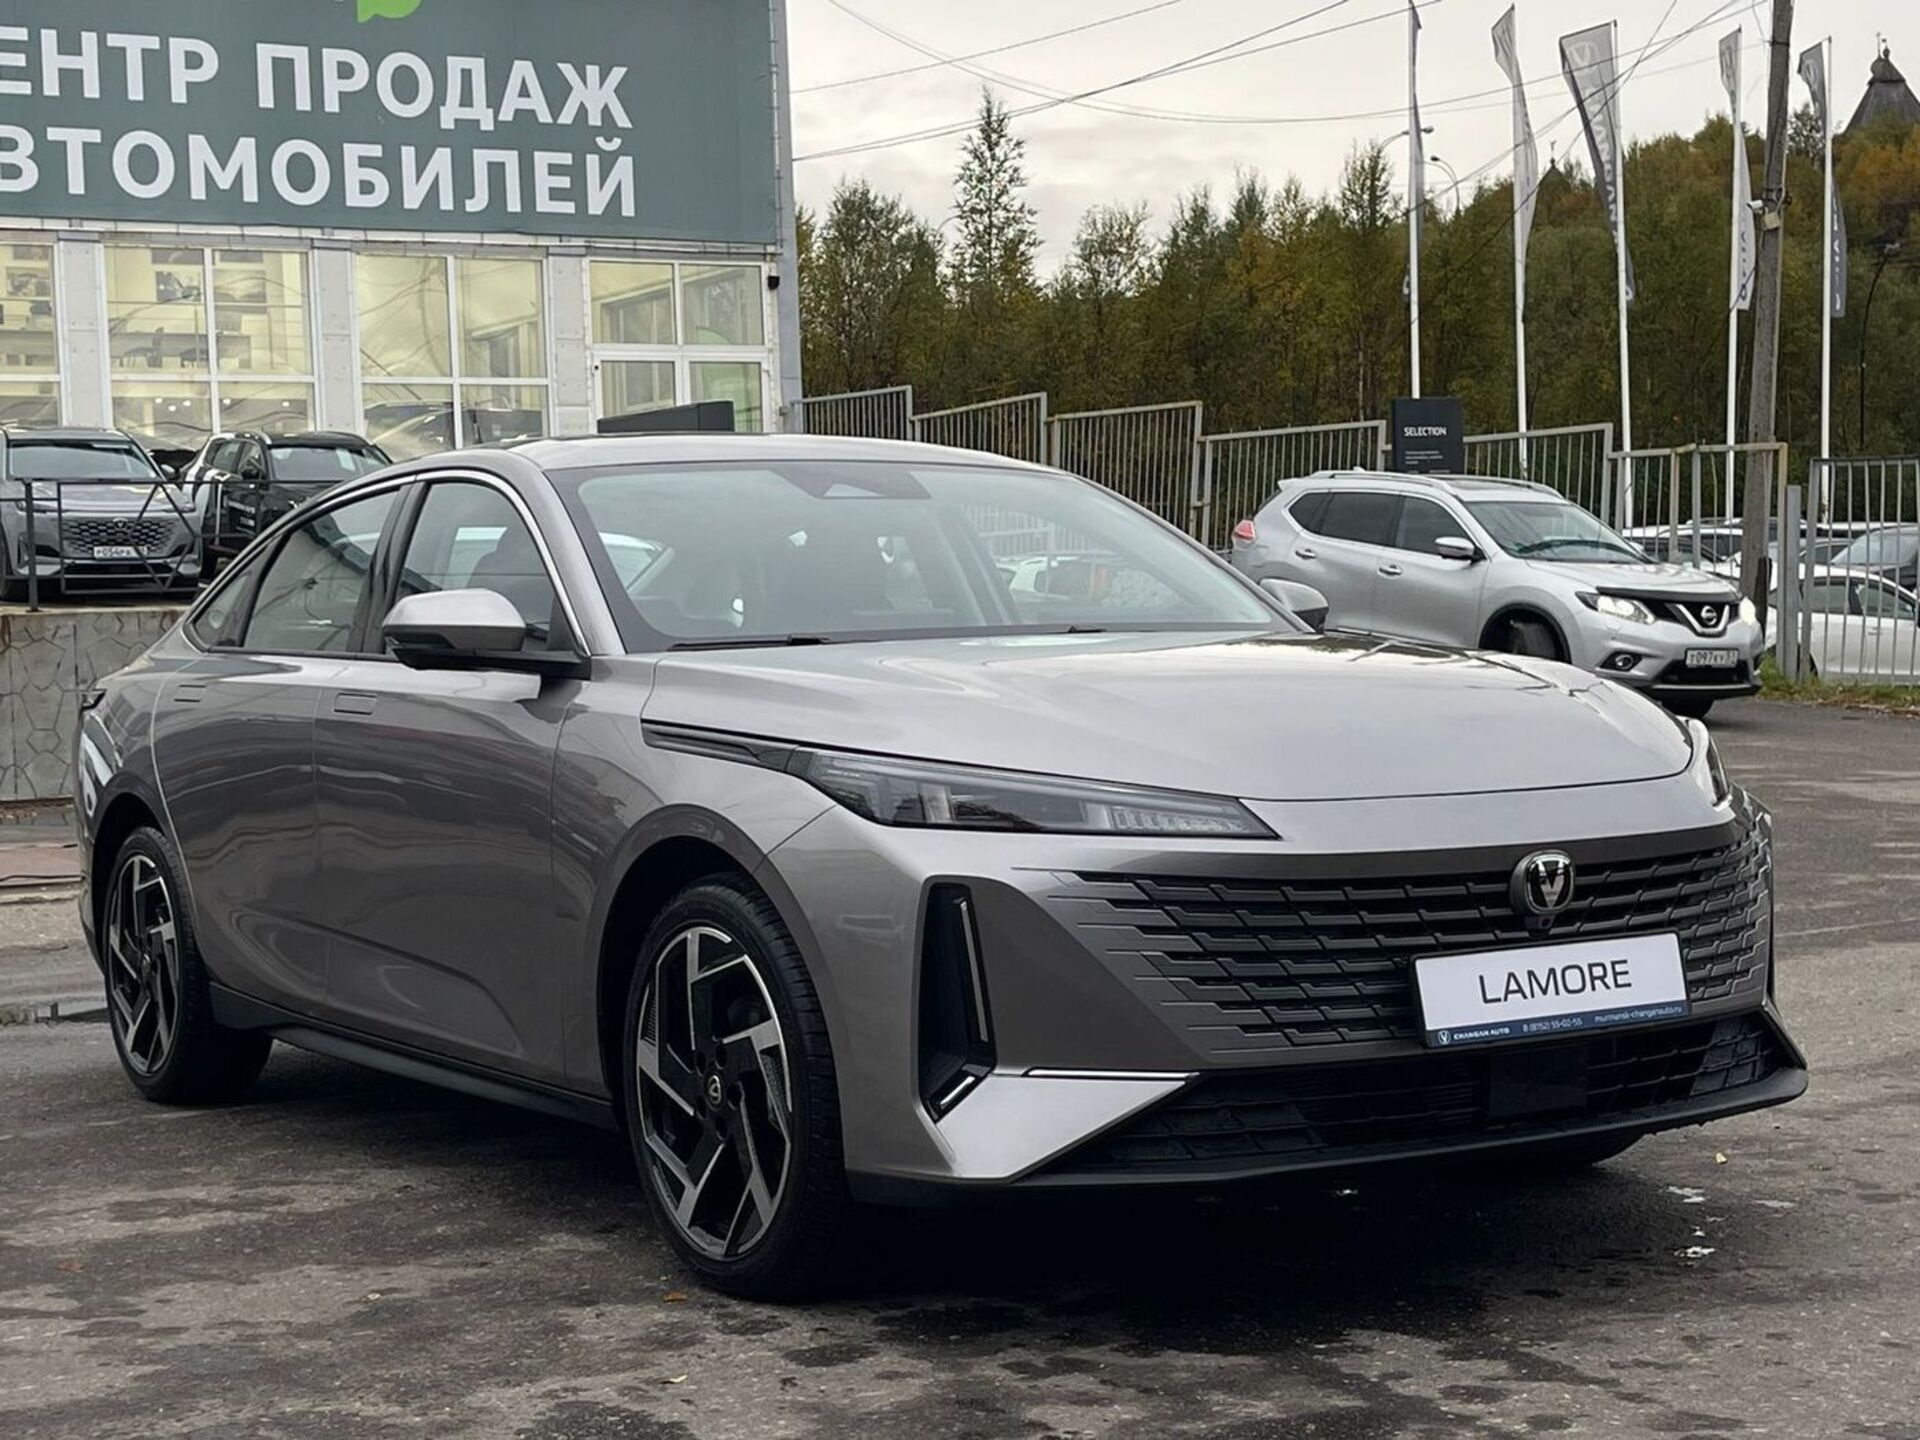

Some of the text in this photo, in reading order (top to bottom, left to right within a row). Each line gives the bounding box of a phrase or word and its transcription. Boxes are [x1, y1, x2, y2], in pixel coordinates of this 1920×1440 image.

[256, 42, 633, 131] ПРОДАЖ
[1404, 426, 1447, 437] SELECTION
[1479, 959, 1632, 1004] LAMORE
[1453, 1030, 1490, 1040] CHANGAN
[1490, 1027, 1510, 1036] AUTO
